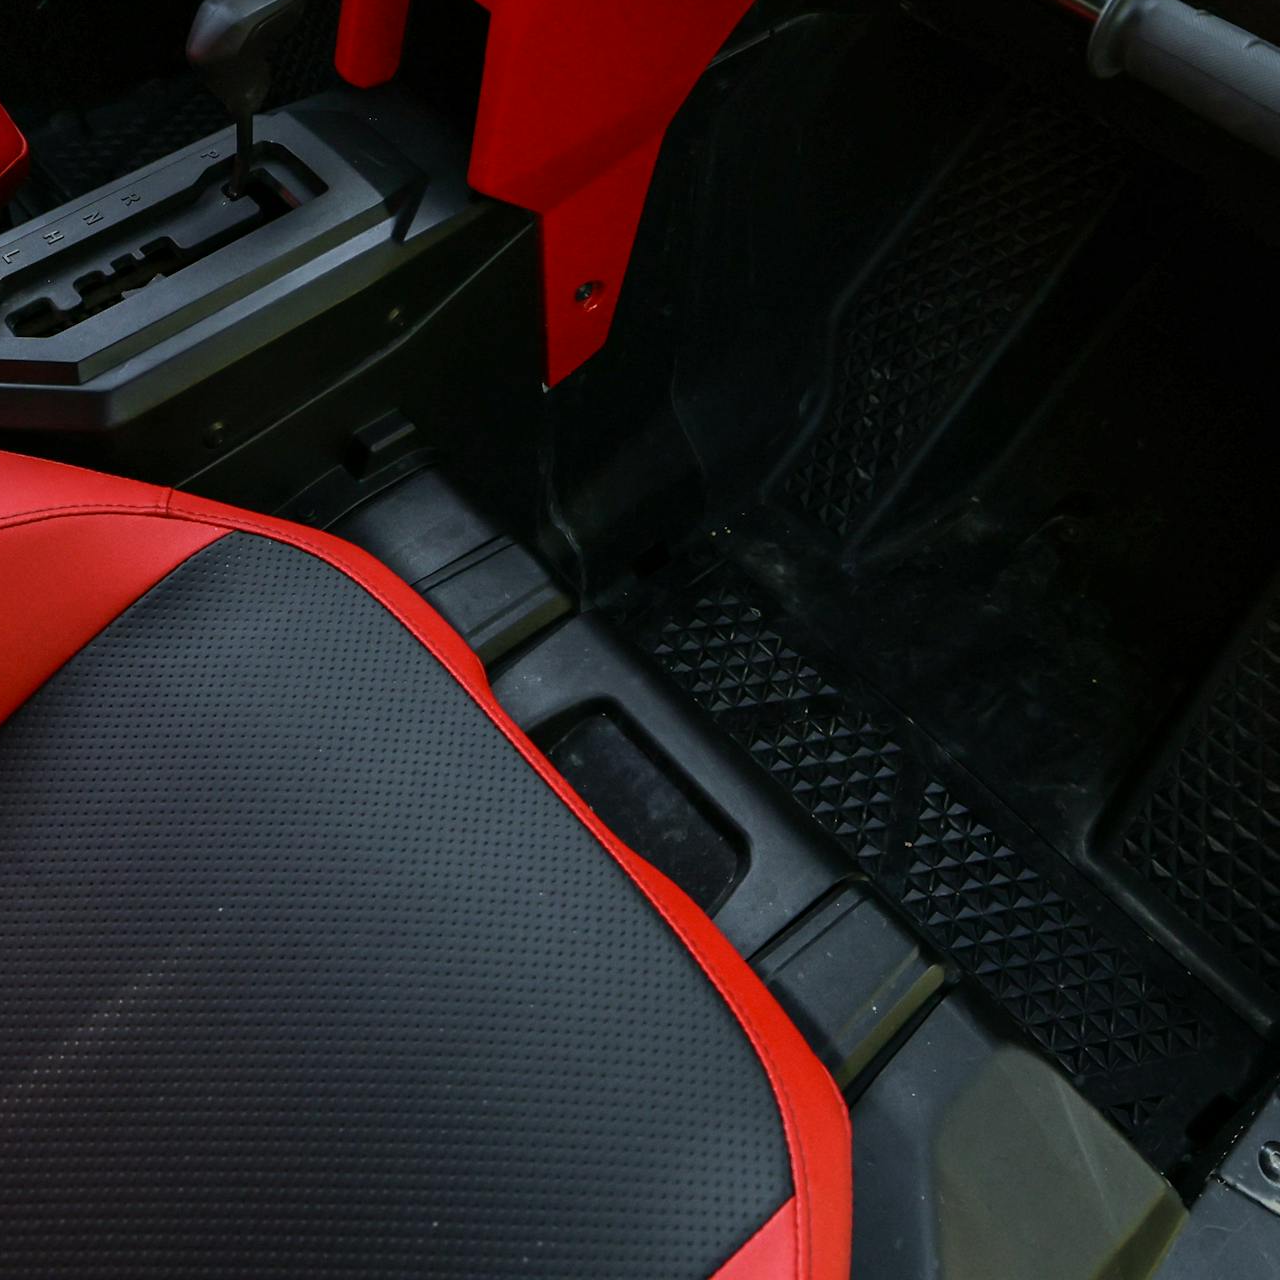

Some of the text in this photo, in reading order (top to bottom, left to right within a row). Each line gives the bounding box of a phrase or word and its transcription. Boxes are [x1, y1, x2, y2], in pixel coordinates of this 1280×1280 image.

[200, 150, 219, 160] P
[121, 192, 141, 207] R
[82, 211, 104, 226] N
[43, 229, 65, 245] H
[1, 248, 20, 264] L
